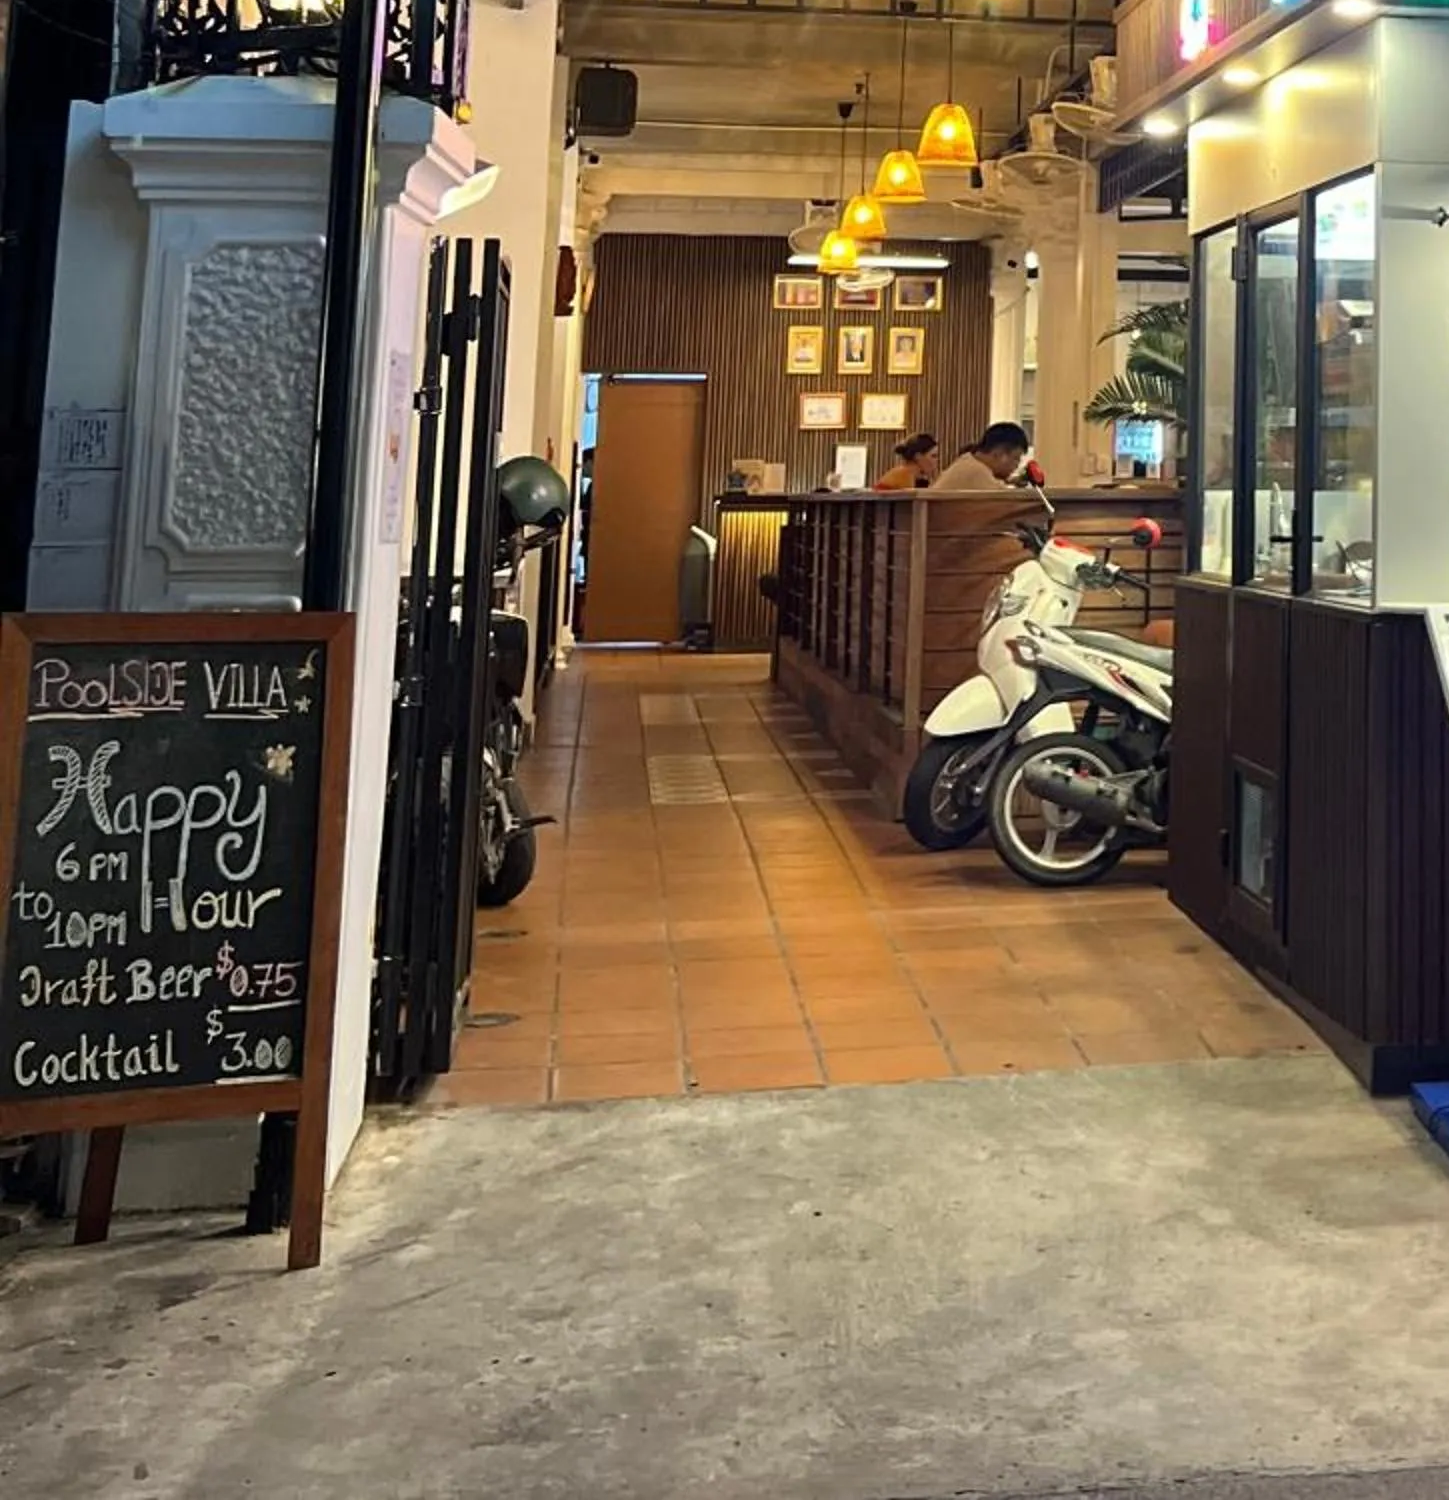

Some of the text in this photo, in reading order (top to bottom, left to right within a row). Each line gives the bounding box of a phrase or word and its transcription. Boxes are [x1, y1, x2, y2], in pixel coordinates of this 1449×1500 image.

[203, 660, 288, 710] VILLA
[36, 739, 267, 881] Happy
[12, 881, 54, 921] to
[140, 877, 283, 933] Hour
[44, 909, 128, 949] 10PM
[19, 957, 118, 1007] Draft
[125, 958, 213, 1004] Beer
[14, 1029, 180, 1087] Cocktail
